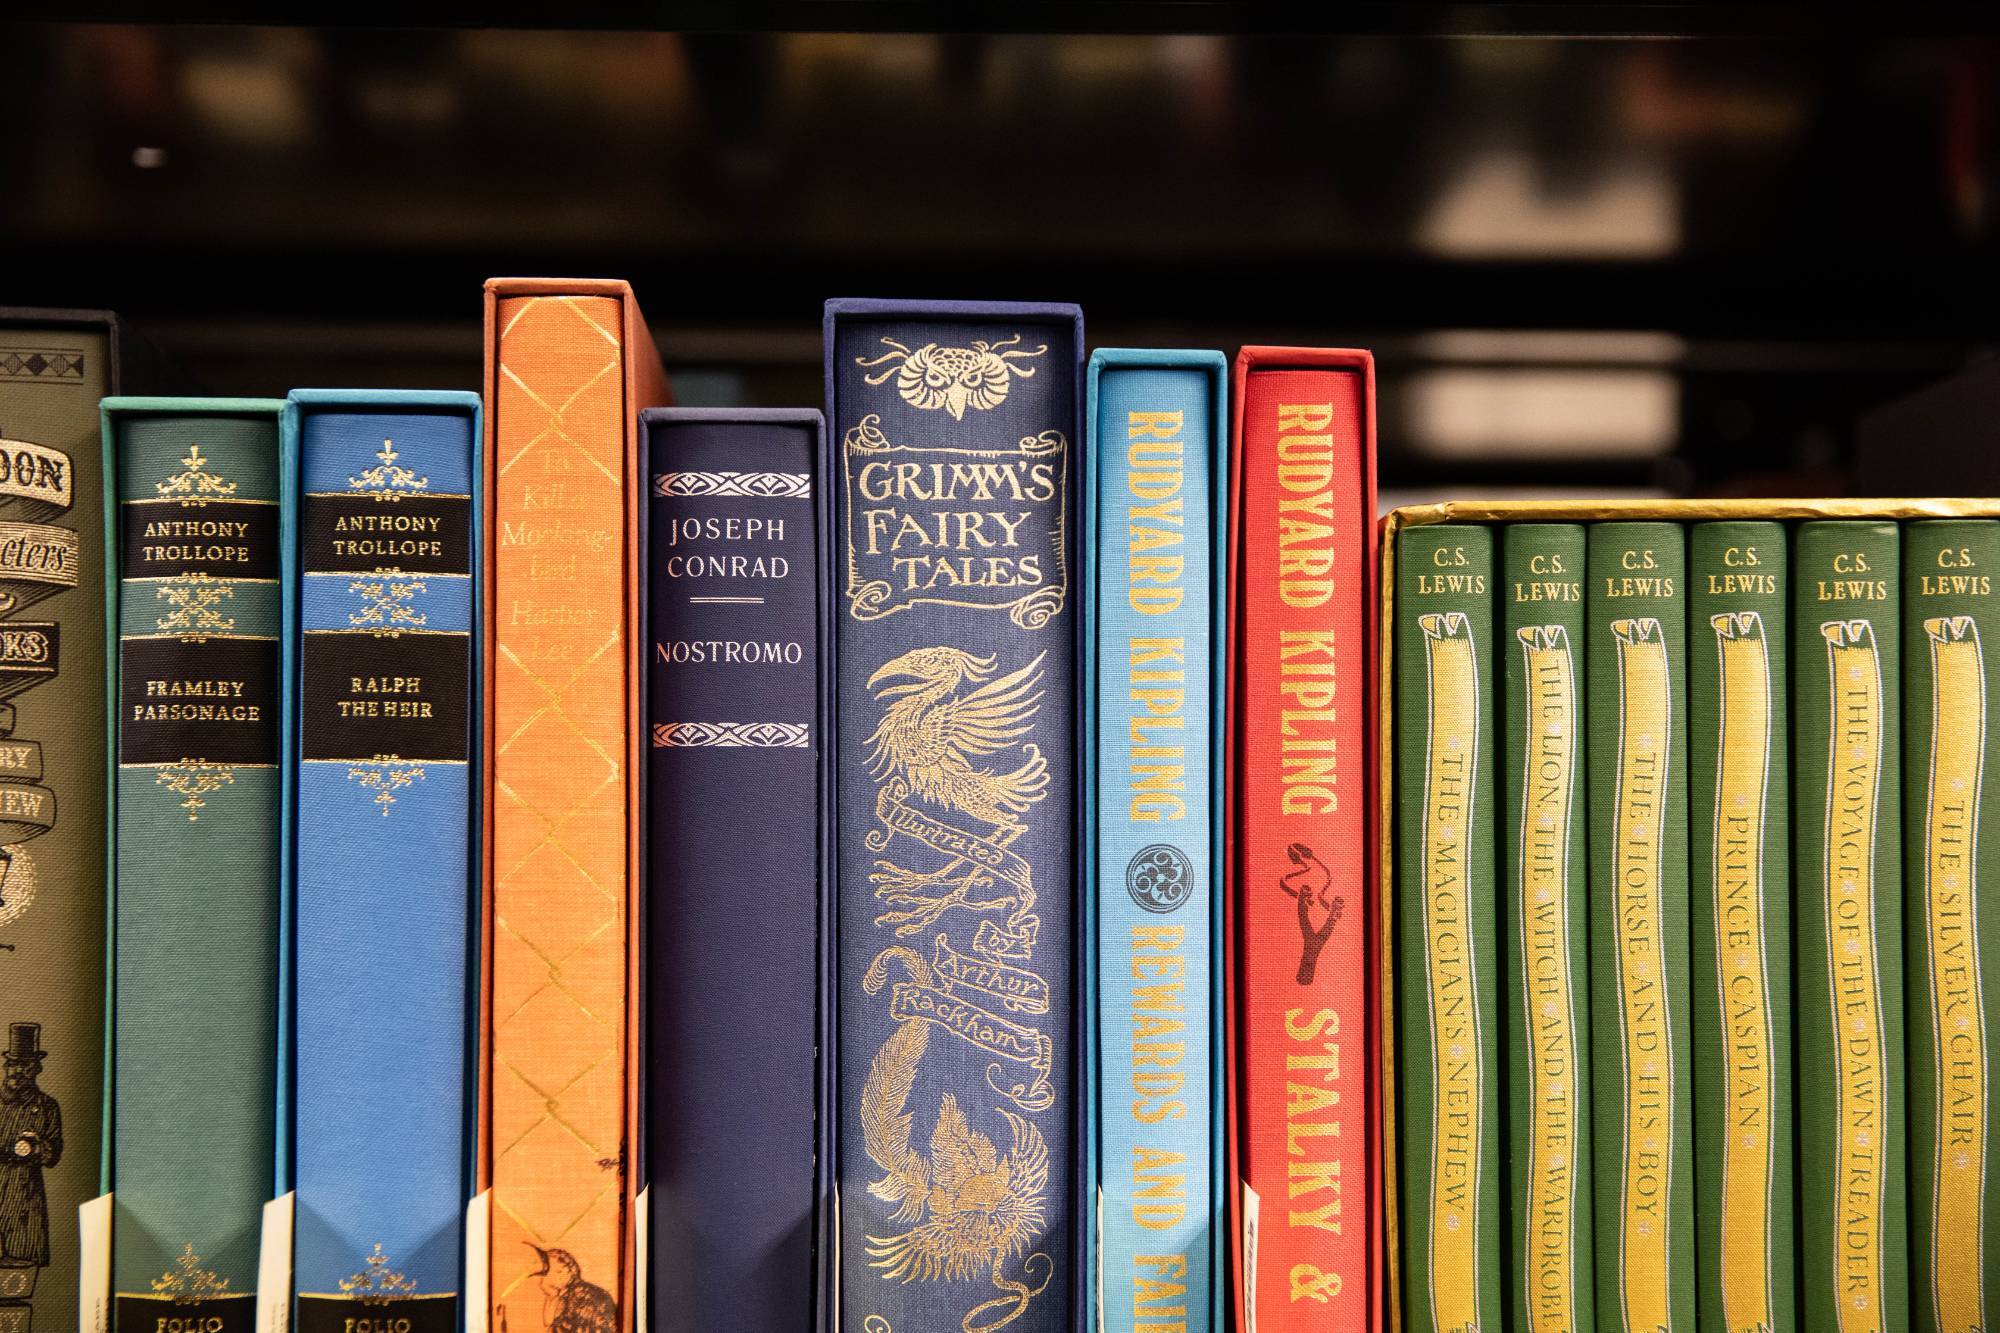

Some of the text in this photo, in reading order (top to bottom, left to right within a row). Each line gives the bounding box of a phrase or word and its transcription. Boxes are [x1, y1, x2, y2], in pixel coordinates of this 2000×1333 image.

[859, 460, 1055, 501] GRIMM'S
[523, 484, 565, 511] Kill
[144, 521, 248, 539] ANTHONY
[335, 515, 441, 533] ANTHONY
[670, 518, 784, 546] JOSEPH
[862, 507, 1032, 555] FAIRY
[142, 546, 249, 562] TROLLOPE
[332, 540, 442, 556] TROLLOPE
[667, 556, 789, 578] CONRAD
[892, 554, 1043, 591] TALES
[1418, 575, 1485, 595] LEWIS
[1515, 582, 1580, 602] LEWIS
[1606, 578, 1674, 597] LEWIS
[1708, 575, 1775, 594] LEWIS
[1817, 581, 1886, 600] LEWIS
[1921, 576, 1991, 595] LEWIS
[1127, 409, 1186, 822] RUDYARD KIPLING
[1276, 402, 1338, 816] RUDYARD KIPLING
[0, 632, 50, 662] KS
[656, 641, 803, 664] NOSTROMO
[146, 681, 244, 697] FRAMLEY
[350, 677, 421, 694] RALPH
[1538, 659, 1564, 718] THE
[133, 704, 260, 722] PARSONAGE
[337, 701, 434, 719] THE HEIR
[1533, 824, 1556, 880] THE
[1532, 901, 1560, 994] WITCH
[940, 954, 1040, 996] Arthur
[1434, 754, 1468, 1212] THE MAGICIAN'S NEPHEW
[1624, 752, 1660, 1218] THE HORSE AND HIS BOY
[1725, 815, 1760, 1129] PRINCE CASPIAN
[1836, 684, 1873, 1293] THE VOYAGE OF THE DAWN TREADER
[1938, 800, 1974, 1148] THE SILVER CHAIR
[900, 988, 1036, 1052] Rackham
[1130, 924, 1187, 1125] REWARDS
[1541, 1016, 1565, 1077] AND
[1546, 1091, 1567, 1148] THE
[1284, 1007, 1343, 1304] STALKY &
[1131, 1144, 1187, 1231] AND
[1540, 1166, 1567, 1327] WARDROBE
[156, 1317, 224, 1333] FOLIO
[345, 1318, 413, 1333] FOLIO
